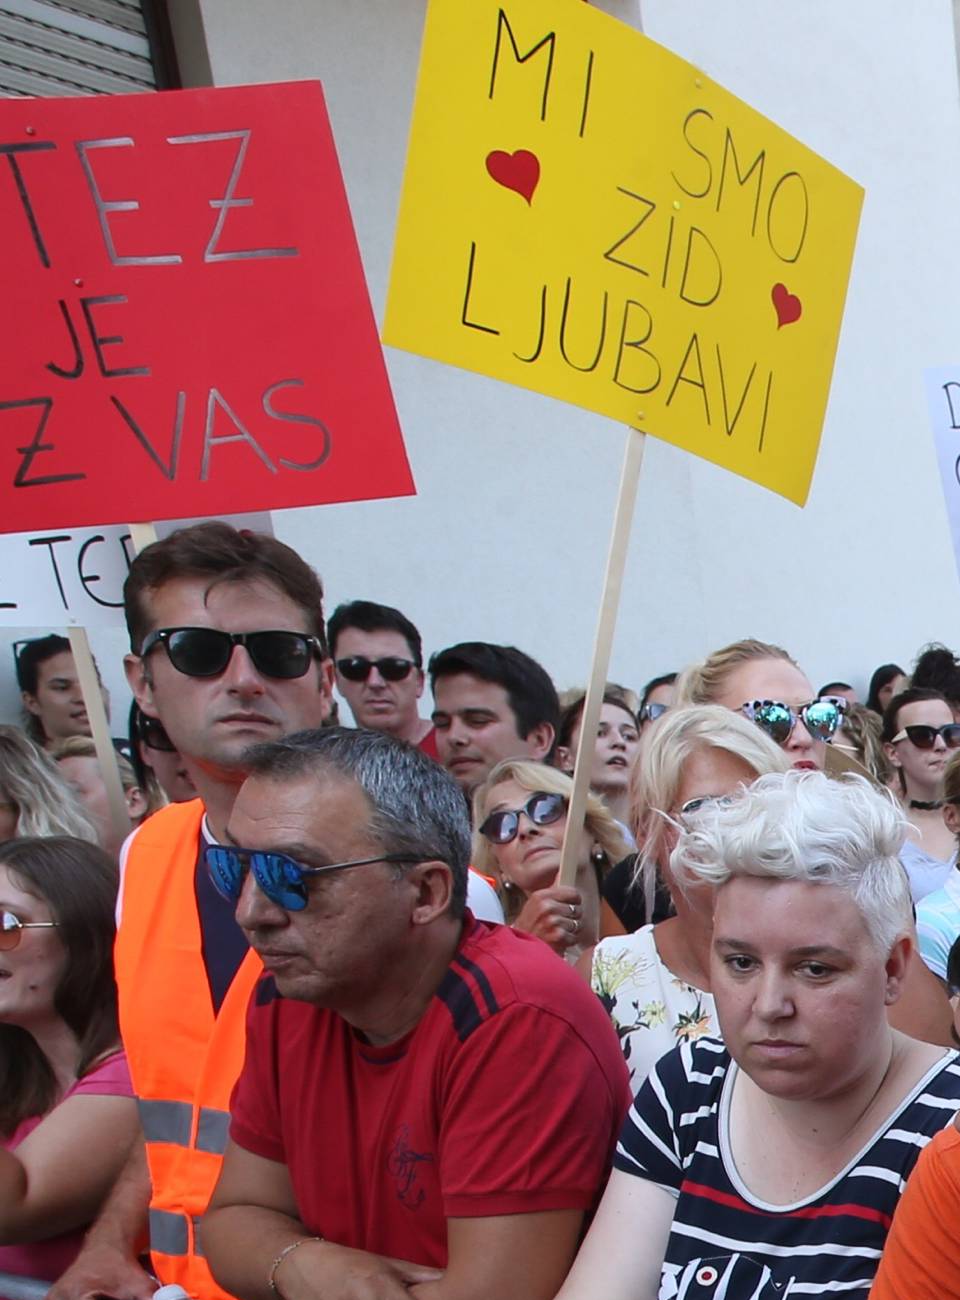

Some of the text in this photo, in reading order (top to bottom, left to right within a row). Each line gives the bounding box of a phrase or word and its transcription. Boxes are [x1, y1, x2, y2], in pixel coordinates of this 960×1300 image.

[488, 8, 809, 264] MI SMO
[602, 186, 723, 307] ZID
[45, 295, 151, 380] JE
[461, 241, 773, 453] LJUBAVI
[110, 378, 332, 481] VAS
